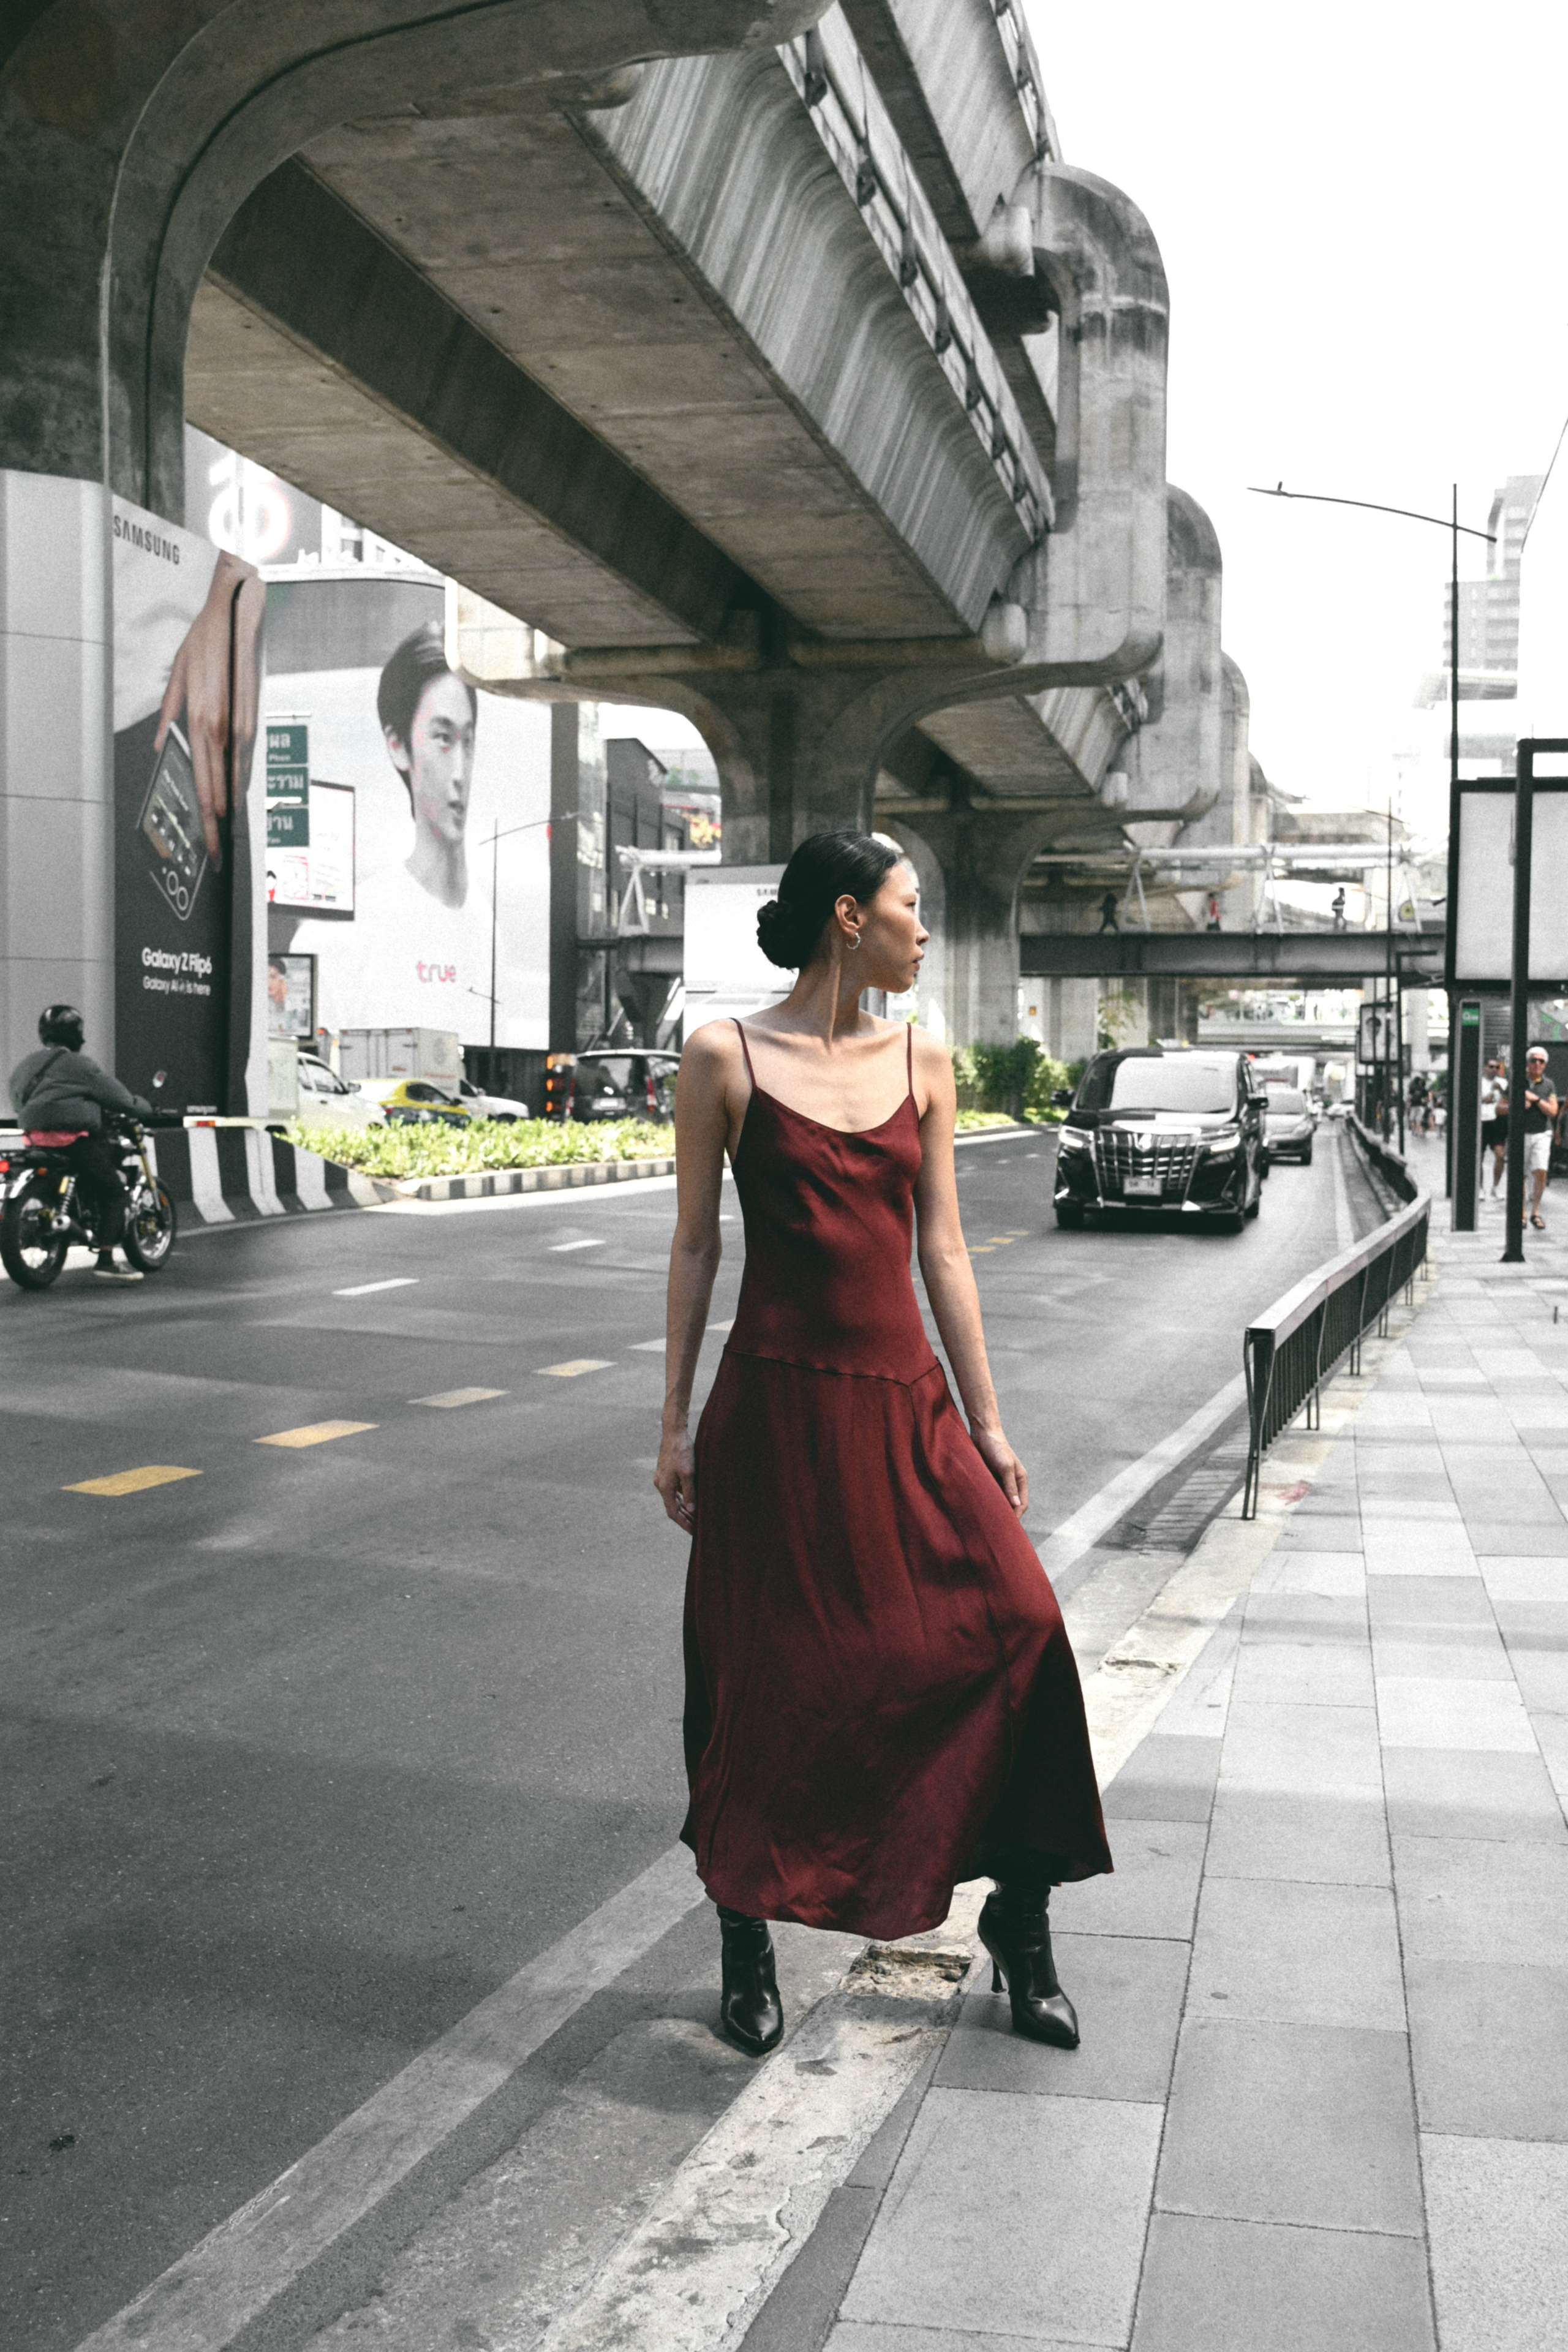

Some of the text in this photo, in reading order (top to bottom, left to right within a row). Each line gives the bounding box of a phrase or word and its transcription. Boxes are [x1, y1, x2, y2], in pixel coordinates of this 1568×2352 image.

[114, 515, 180, 565] SAMSUNG
[141, 946, 213, 979] Galaxy Z Flip6
[416, 960, 456, 983] true
[143, 975, 171, 995] Galaxy
